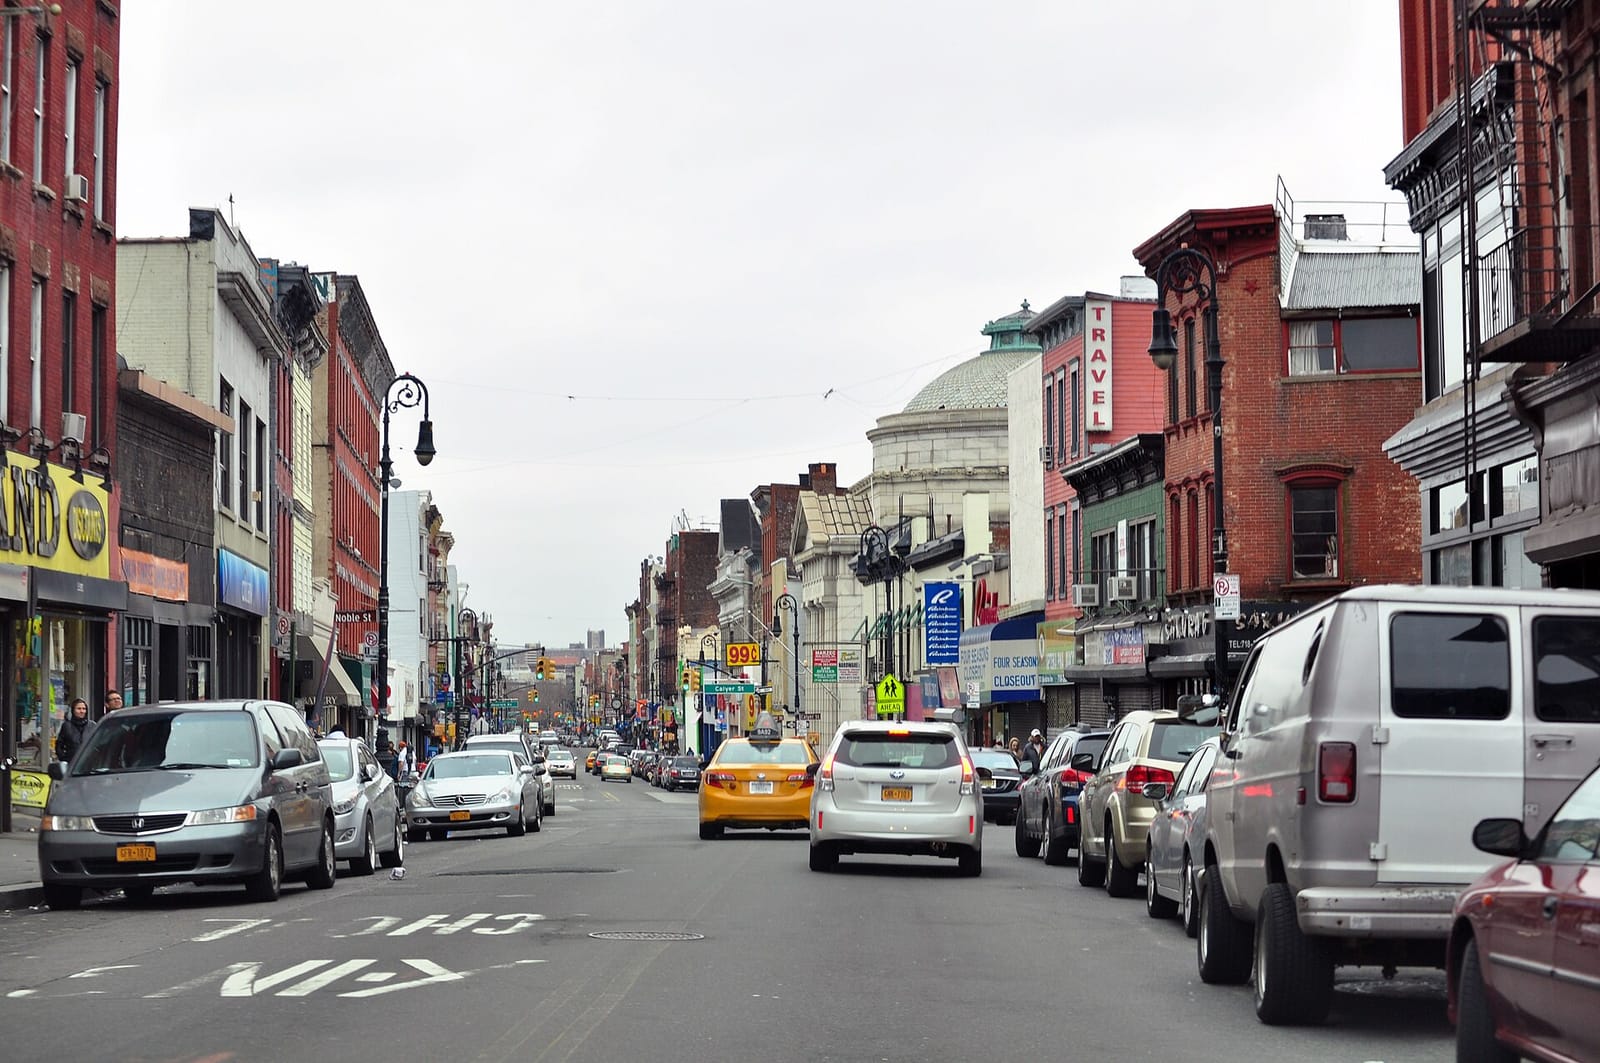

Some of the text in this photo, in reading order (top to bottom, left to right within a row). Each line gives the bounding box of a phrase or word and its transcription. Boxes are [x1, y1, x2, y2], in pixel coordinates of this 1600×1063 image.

[1091, 307, 1107, 426] TRAVEL
[336, 614, 372, 623] Noble St
[993, 656, 1010, 668] FOUR
[994, 674, 1036, 687] CLOSEOUT
[880, 703, 900, 711] AHEAD
